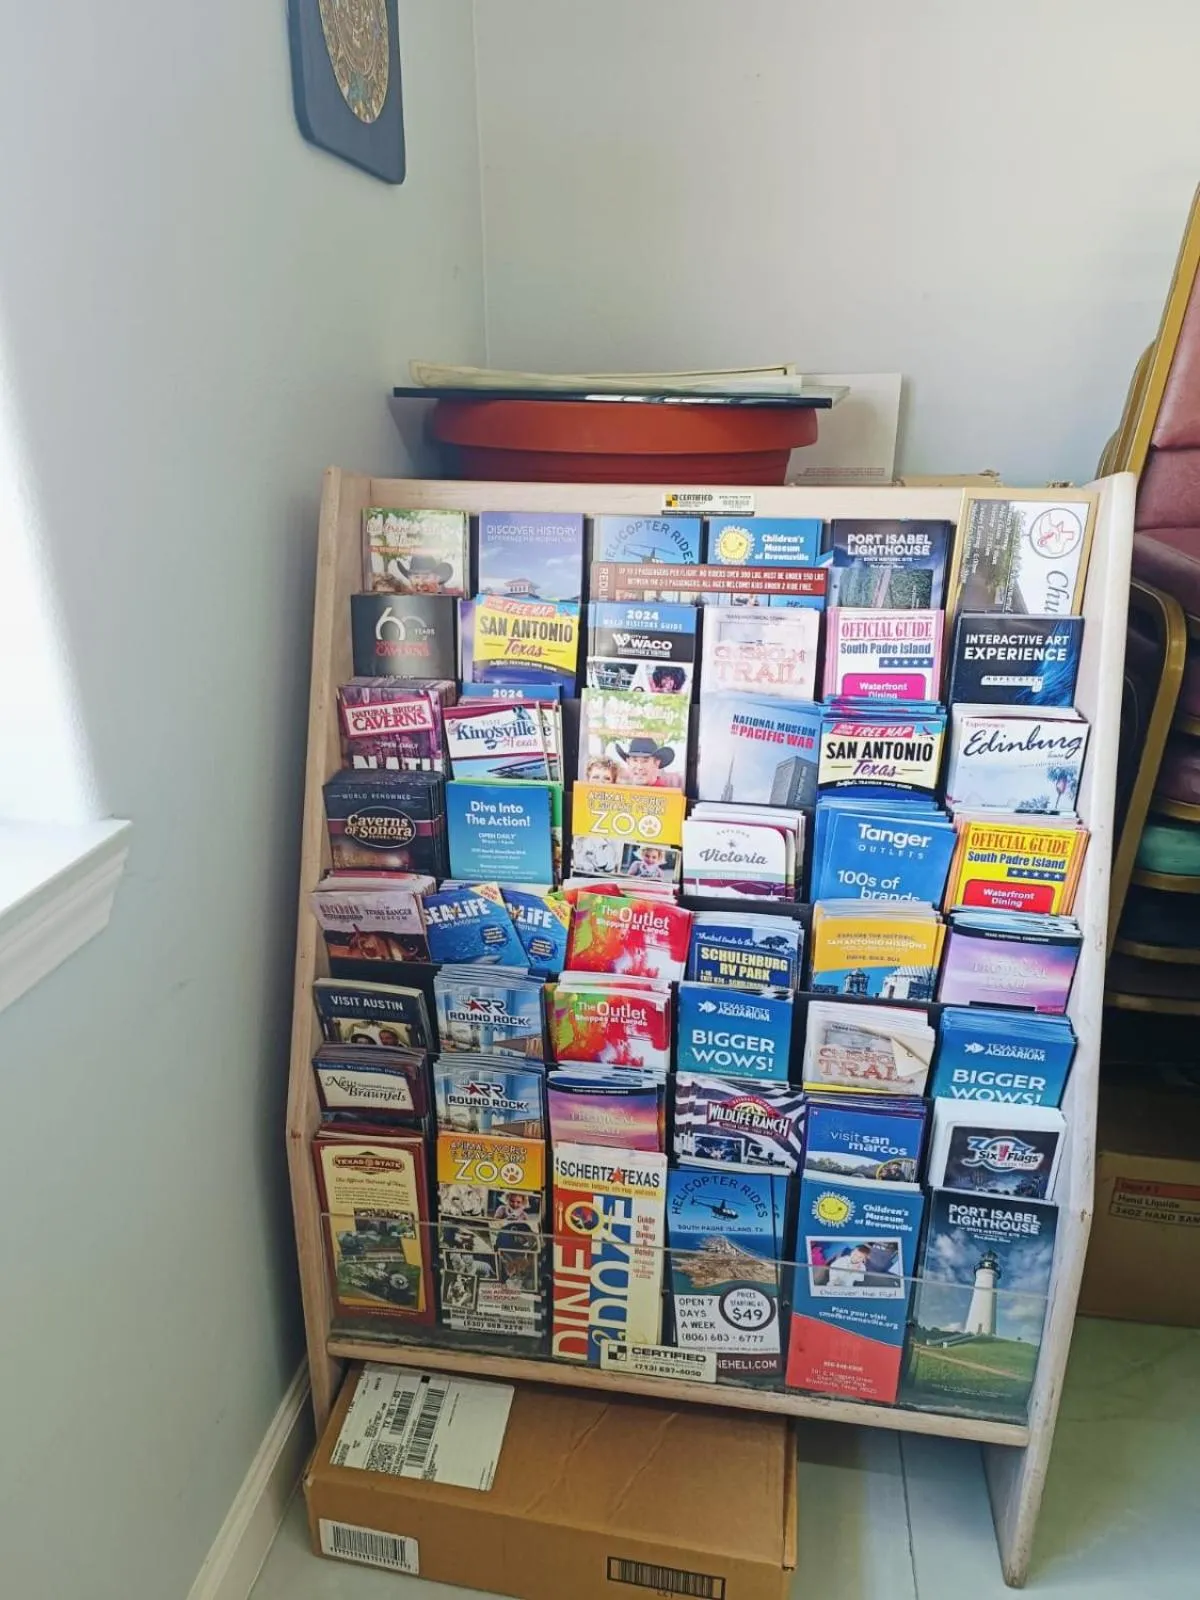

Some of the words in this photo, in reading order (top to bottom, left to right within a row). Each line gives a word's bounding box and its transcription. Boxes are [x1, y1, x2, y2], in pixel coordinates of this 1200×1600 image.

[679, 493, 713, 502] CERTIFIED
[487, 525, 532, 536] DISCOVER
[536, 526, 577, 537] HISTORY
[762, 534, 804, 544] Children's
[848, 534, 882, 546] PORT
[885, 534, 932, 546] ISABEL
[765, 544, 800, 553] Museum
[847, 544, 931, 556] LIGHTHOUSE
[765, 552, 809, 562] Brownsville
[504, 602, 531, 615] FREE
[532, 606, 555, 617] MAP
[627, 609, 659, 621] 2024
[480, 615, 508, 637] SAN
[511, 619, 573, 643] ANTONIO
[625, 620, 658, 629] VISITORS
[660, 622, 683, 631] GUIDE
[842, 621, 893, 639] OFFICIAL
[895, 621, 933, 638] GUIDE
[504, 638, 548, 657] Texas
[630, 639, 673, 651] WACO
[965, 634, 1043, 646] INTERACTIVE
[1045, 635, 1070, 646] ART
[841, 643, 868, 655] South
[870, 643, 897, 655] Padre
[900, 643, 931, 655] Island
[964, 647, 1067, 662] EXPERIENCE
[714, 660, 805, 685] TRAIL
[492, 689, 524, 699] 2024
[859, 681, 908, 692] Waterfront
[868, 691, 898, 700] Dining
[351, 707, 391, 719] NATURAL
[392, 704, 425, 717] BRIDGE
[352, 711, 427, 731] CAVERNS
[732, 714, 775, 730] NATIONAL
[776, 722, 816, 737] MUSEUM
[456, 719, 537, 748] Kingsville
[740, 726, 784, 744] PACIFIC
[787, 734, 815, 749] WAR
[854, 726, 884, 737] FREE
[885, 726, 912, 738] MAP
[963, 724, 1083, 760] Edinburg
[826, 741, 857, 759] SAN
[862, 741, 934, 762] ANTONIO
[853, 759, 904, 777] Texas
[342, 792, 368, 800] WORLD
[371, 793, 412, 801] RENOWNED
[470, 801, 497, 813] Dive
[498, 803, 524, 814] Into
[347, 814, 409, 828] Caverns
[465, 812, 486, 825] The
[487, 814, 531, 828] Action!
[590, 810, 662, 838] ZOO
[359, 824, 412, 838] Sonora
[858, 822, 932, 849] Tanger
[971, 832, 1025, 852] OFFICIAL
[1028, 836, 1070, 855] GUIDE
[699, 848, 768, 865] Victoria
[858, 844, 924, 860] OUTLETS
[968, 851, 997, 864] South
[1000, 853, 1029, 867] Padre
[1031, 854, 1066, 869] Island
[837, 869, 878, 887] 100s
[880, 876, 901, 890] of
[983, 887, 1035, 900] Waterfront
[991, 897, 1023, 908] Dining
[601, 904, 618, 917] The
[619, 907, 670, 931] Outlet
[700, 946, 788, 972] SCHULENBURG
[719, 962, 737, 977] RV
[739, 966, 770, 981] PARK
[330, 995, 361, 1007] VISIT
[363, 997, 404, 1011] AUSTIN
[718, 1002, 743, 1011] TEXAS
[744, 1004, 770, 1013] STATE
[449, 1011, 491, 1022] ROUND
[493, 1014, 527, 1026] ROCK
[578, 1001, 596, 1013] The
[596, 1001, 647, 1021] Outlet
[717, 1008, 770, 1021] AQUARIUM
[575, 1014, 608, 1026] Shoppes
[620, 1017, 648, 1027] Laredo
[692, 1030, 776, 1055] BIGGER
[987, 1043, 1013, 1052] TEXAS
[1017, 1046, 1046, 1055] STATE
[691, 1047, 773, 1072] WOWS!
[985, 1049, 1046, 1062] AQUARIUM
[325, 1075, 357, 1091] New
[952, 1068, 1046, 1091] BIGGER
[348, 1087, 406, 1102] Braunfels
[950, 1085, 1042, 1106] WOWS!
[448, 1095, 490, 1106] ROUND
[492, 1098, 524, 1110] ROCK
[708, 1103, 752, 1127] WILDLIFE
[751, 1116, 789, 1138] RANCH
[830, 1130, 861, 1142] visit
[862, 1134, 890, 1146] san
[849, 1142, 907, 1156] marcos
[978, 1150, 997, 1161] Six
[1006, 1152, 1039, 1164] Flags
[374, 1161, 401, 1169] STATE
[454, 1159, 524, 1185] ZOO
[560, 1161, 614, 1182] SCHERTZ
[621, 1169, 660, 1188] TEXAS
[672, 1175, 738, 1215] HELICOPTER
[739, 1185, 768, 1219] RIDES
[863, 1203, 909, 1217] Children's
[865, 1212, 905, 1223] Museum
[949, 1203, 988, 1218] PORT
[990, 1206, 1042, 1225] ISABEL
[638, 1216, 656, 1225] Guide
[677, 1224, 698, 1232] SOUTH
[865, 1220, 913, 1232] Brownsville
[948, 1214, 1042, 1235] LIGHTHOUSE
[636, 1231, 655, 1241] Dining
[552, 1242, 592, 1361] DINE
[679, 1298, 706, 1307] OPEN
[708, 1298, 714, 1307] 7
[736, 1291, 756, 1299] PRICES
[679, 1309, 707, 1318] DAYS
[732, 1307, 763, 1321] $49
[831, 1306, 849, 1315] Plan
[850, 1309, 868, 1318] your
[869, 1312, 887, 1320] visit
[681, 1321, 688, 1329] A
[690, 1321, 716, 1329] WEEK
[682, 1333, 708, 1343] (806)
[631, 1346, 707, 1363] CERTIFIED
